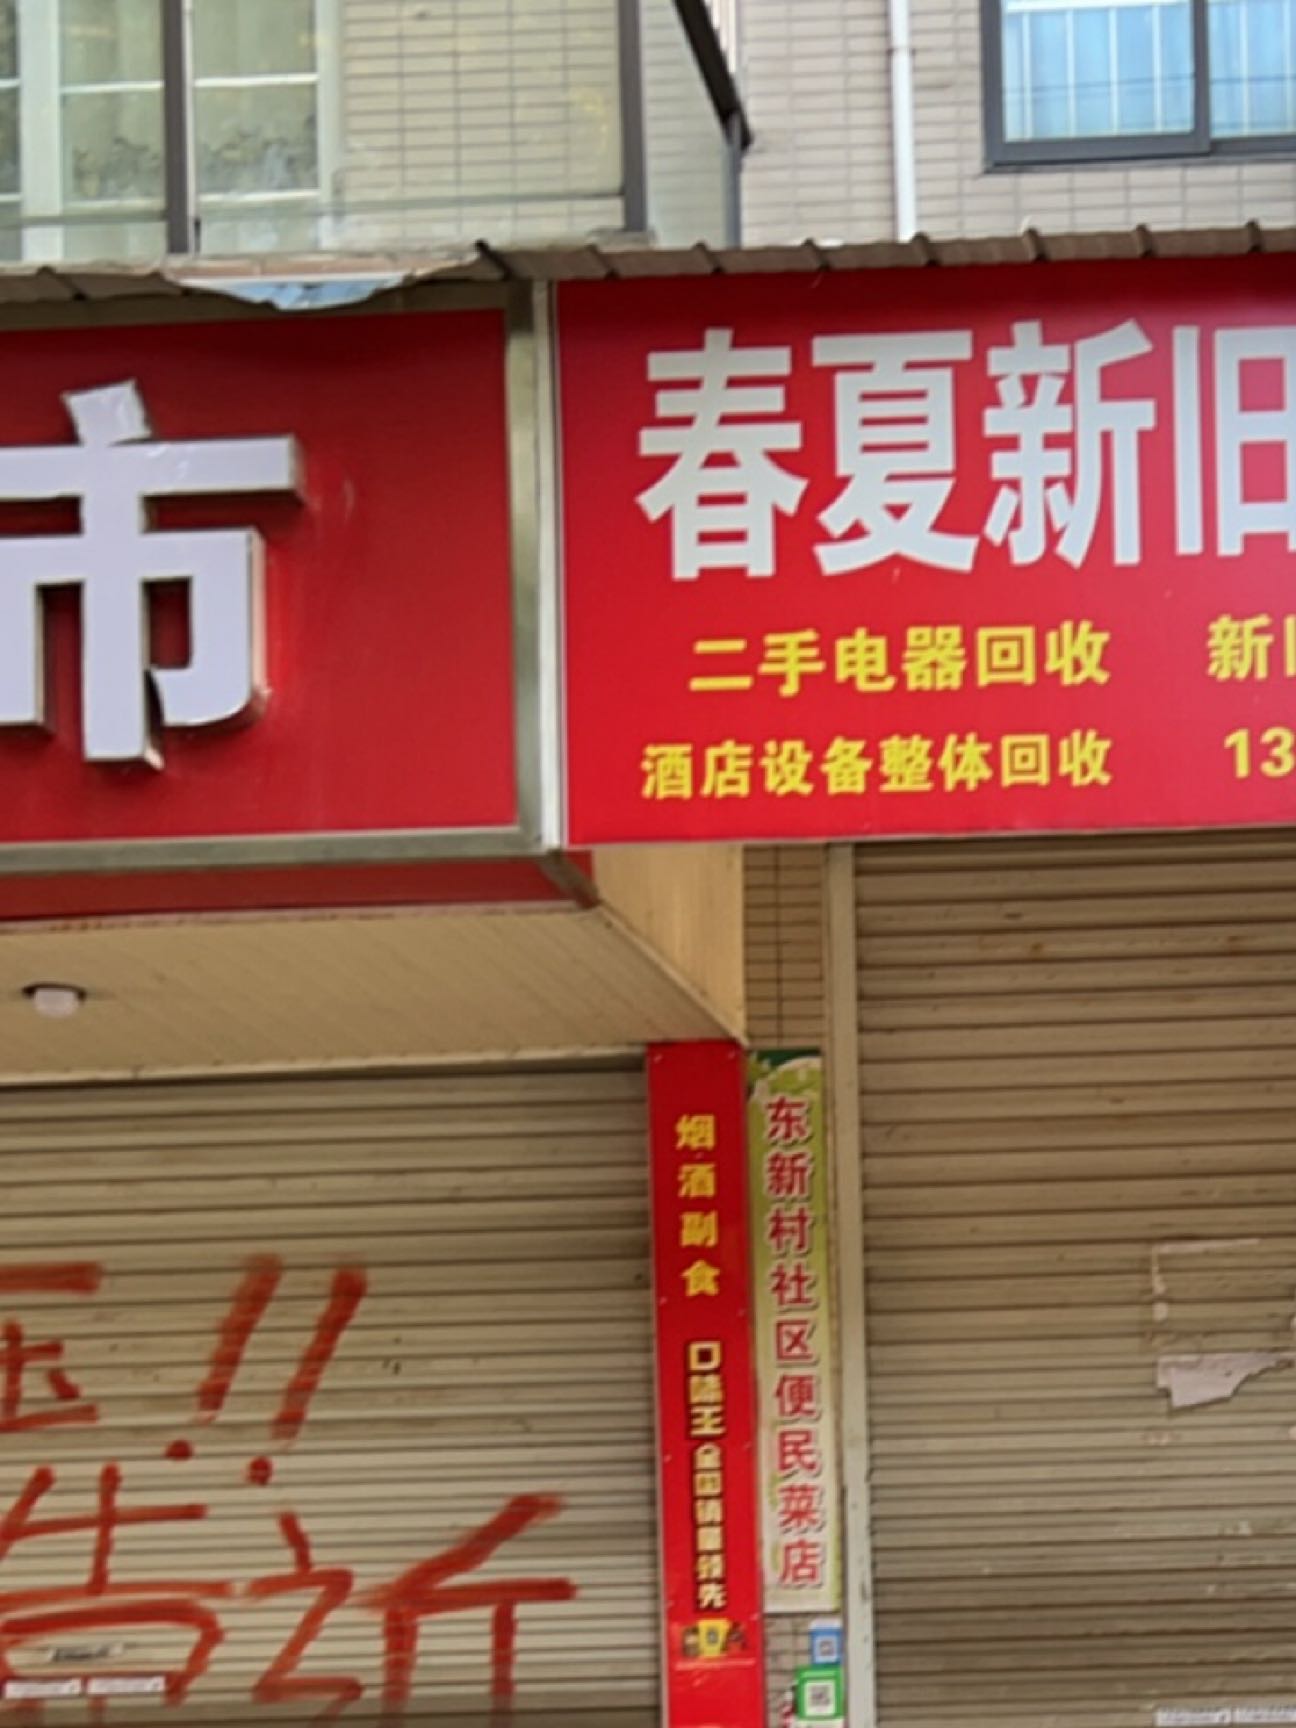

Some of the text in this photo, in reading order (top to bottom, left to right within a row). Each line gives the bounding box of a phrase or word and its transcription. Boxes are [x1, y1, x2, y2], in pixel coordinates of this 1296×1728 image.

[0, 379, 303, 769] 市
[690, 620, 1111, 697] 二手电器回收
[641, 729, 1112, 800] 酒店设备整体回收
[675, 1113, 721, 1297] 烟酒副食
[765, 1096, 824, 1589] 东新村社区便民菜店
